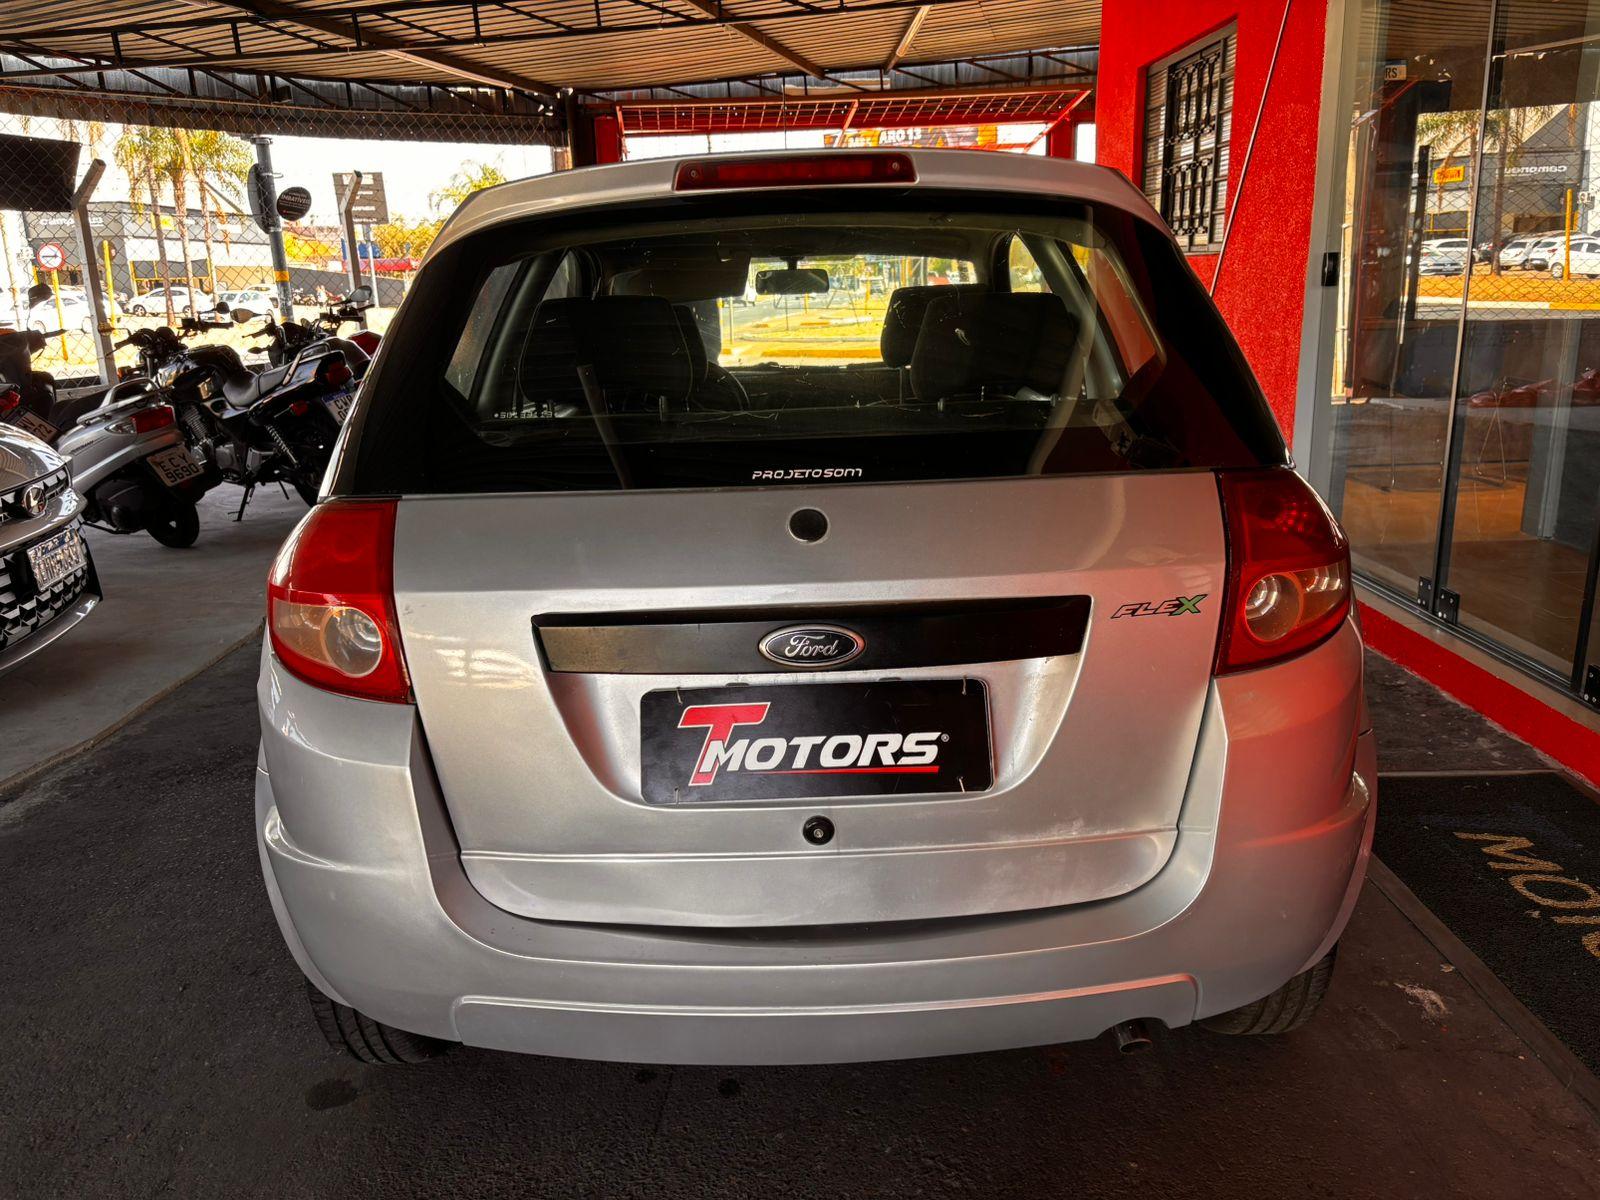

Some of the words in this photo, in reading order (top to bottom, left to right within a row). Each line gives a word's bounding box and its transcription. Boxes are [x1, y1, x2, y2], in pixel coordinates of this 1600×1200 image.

[1385, 67, 1398, 79] RS
[879, 129, 906, 144] ARO
[159, 452, 189, 472] ECY
[165, 463, 200, 483] 9690
[1110, 594, 1208, 619] FLEX
[784, 634, 840, 658] Ford
[699, 731, 943, 773] MOTORS
